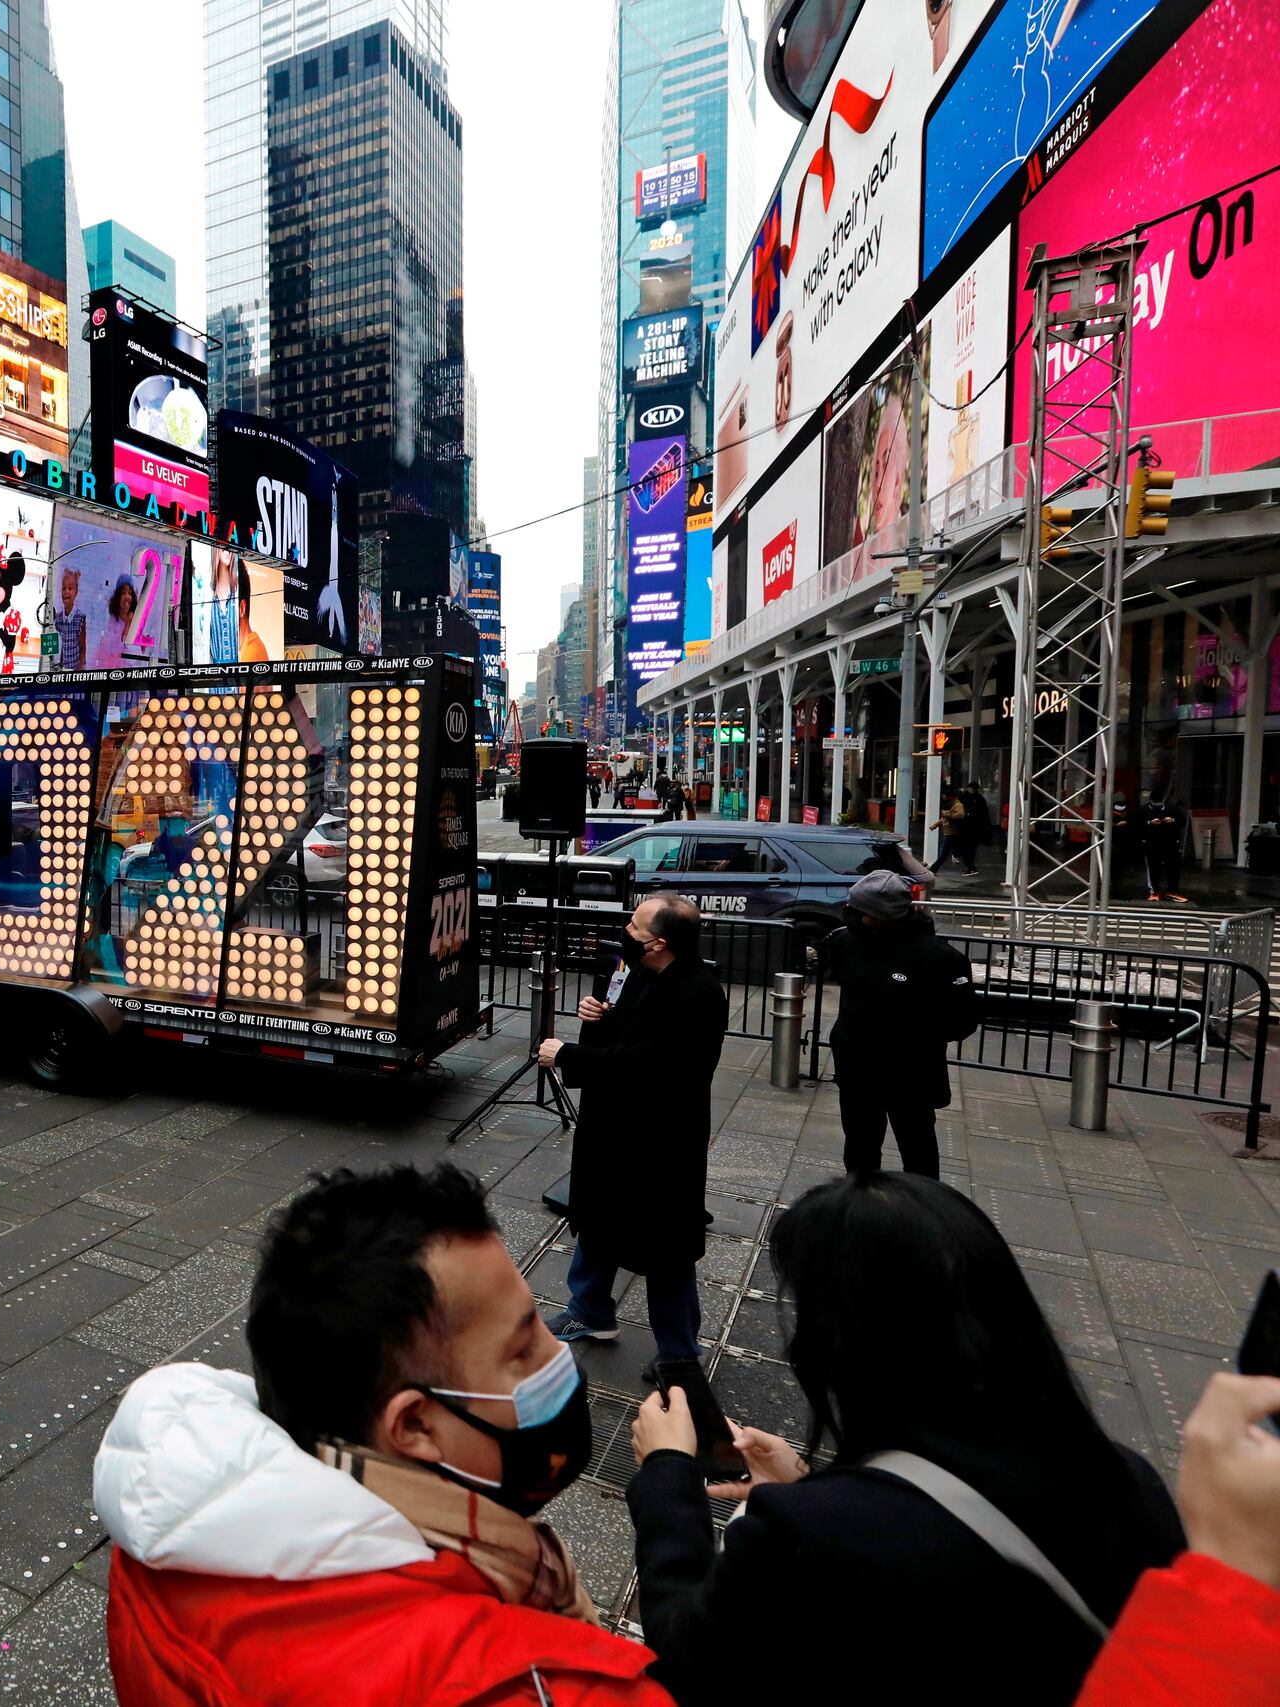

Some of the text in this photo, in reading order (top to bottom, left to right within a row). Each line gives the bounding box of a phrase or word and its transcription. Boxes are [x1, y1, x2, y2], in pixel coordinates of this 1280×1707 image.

[1046, 86, 1097, 153] MARRIOTT
[1045, 116, 1090, 174] MARQUIS
[684, 171, 695, 181] 15
[683, 187, 695, 196] Eve
[803, 131, 898, 309] Make their year,
[650, 233, 683, 251] 2020
[1188, 190, 1254, 280] On
[810, 214, 884, 344] with Galaxy
[956, 270, 977, 315] VOCE
[124, 305, 134, 319] LG
[93, 328, 105, 340] LG
[637, 317, 688, 339] A 281-HP
[717, 309, 737, 360] SAMSUNG
[956, 304, 975, 346] VIVA
[644, 332, 681, 350] STORY
[639, 345, 685, 367] TELLING
[636, 360, 688, 382] MACHINE
[647, 408, 678, 425] KIA
[234, 426, 256, 436] BASED
[269, 433, 279, 442] THE
[142, 459, 154, 476] LG
[46, 459, 260, 550] BROADWAY
[256, 475, 308, 568] STAND
[293, 605, 309, 620] ACCESS
[52, 673, 65, 682] GIVE
[72, 671, 108, 682] EVERYTHING
[126, 668, 157, 679] #KiaNYE
[178, 665, 250, 676] SORENTO
[272, 662, 289, 673] GIVE
[298, 660, 342, 671] EVERYTHING
[371, 657, 410, 669] #KiaNYE
[415, 658, 431, 667] KIA
[862, 660, 889, 673] W 46
[449, 710, 464, 734] KIA
[445, 816, 463, 832] TIMES
[448, 831, 469, 850] SQUARE
[438, 873, 466, 888] SORENTO
[700, 895, 747, 912] NEWS
[429, 886, 471, 956] 2021
[144, 1003, 216, 1020] SORENTO
[239, 1014, 254, 1026] GIVE
[265, 1016, 310, 1033] EVERYTHING
[333, 1027, 373, 1041] #KiaNYE
[378, 1033, 394, 1042] KIA
[436, 1007, 459, 1031] #KiaNYE
